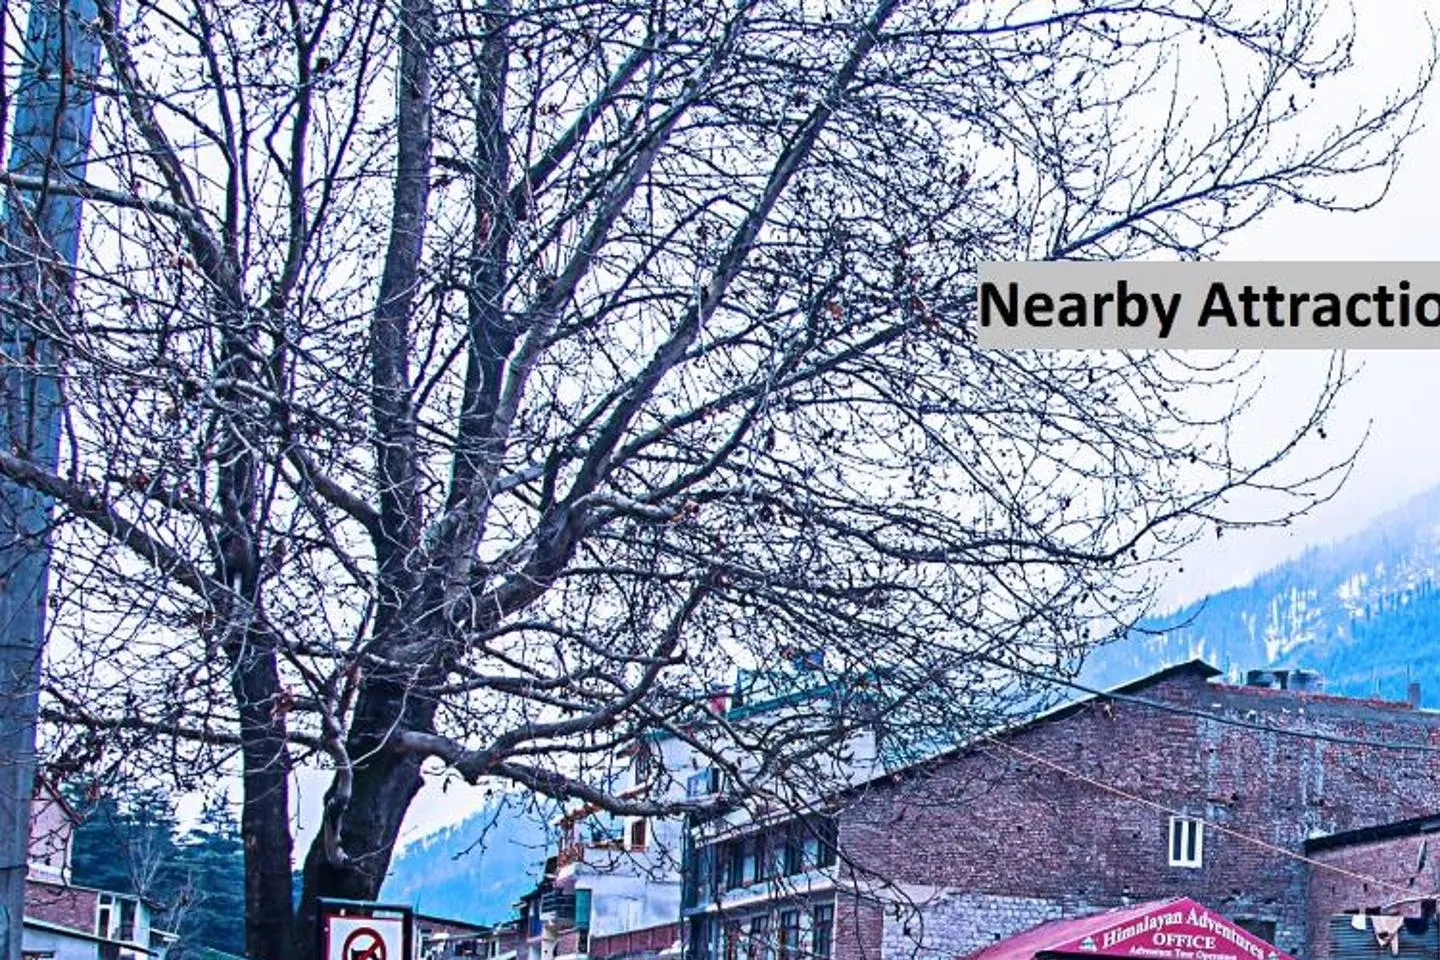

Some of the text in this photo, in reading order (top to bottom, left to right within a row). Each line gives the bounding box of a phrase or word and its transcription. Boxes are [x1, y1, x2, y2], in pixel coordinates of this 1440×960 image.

[1102, 907, 1265, 960] Himalayan Adventures
[1152, 932, 1217, 949] OFFICE
